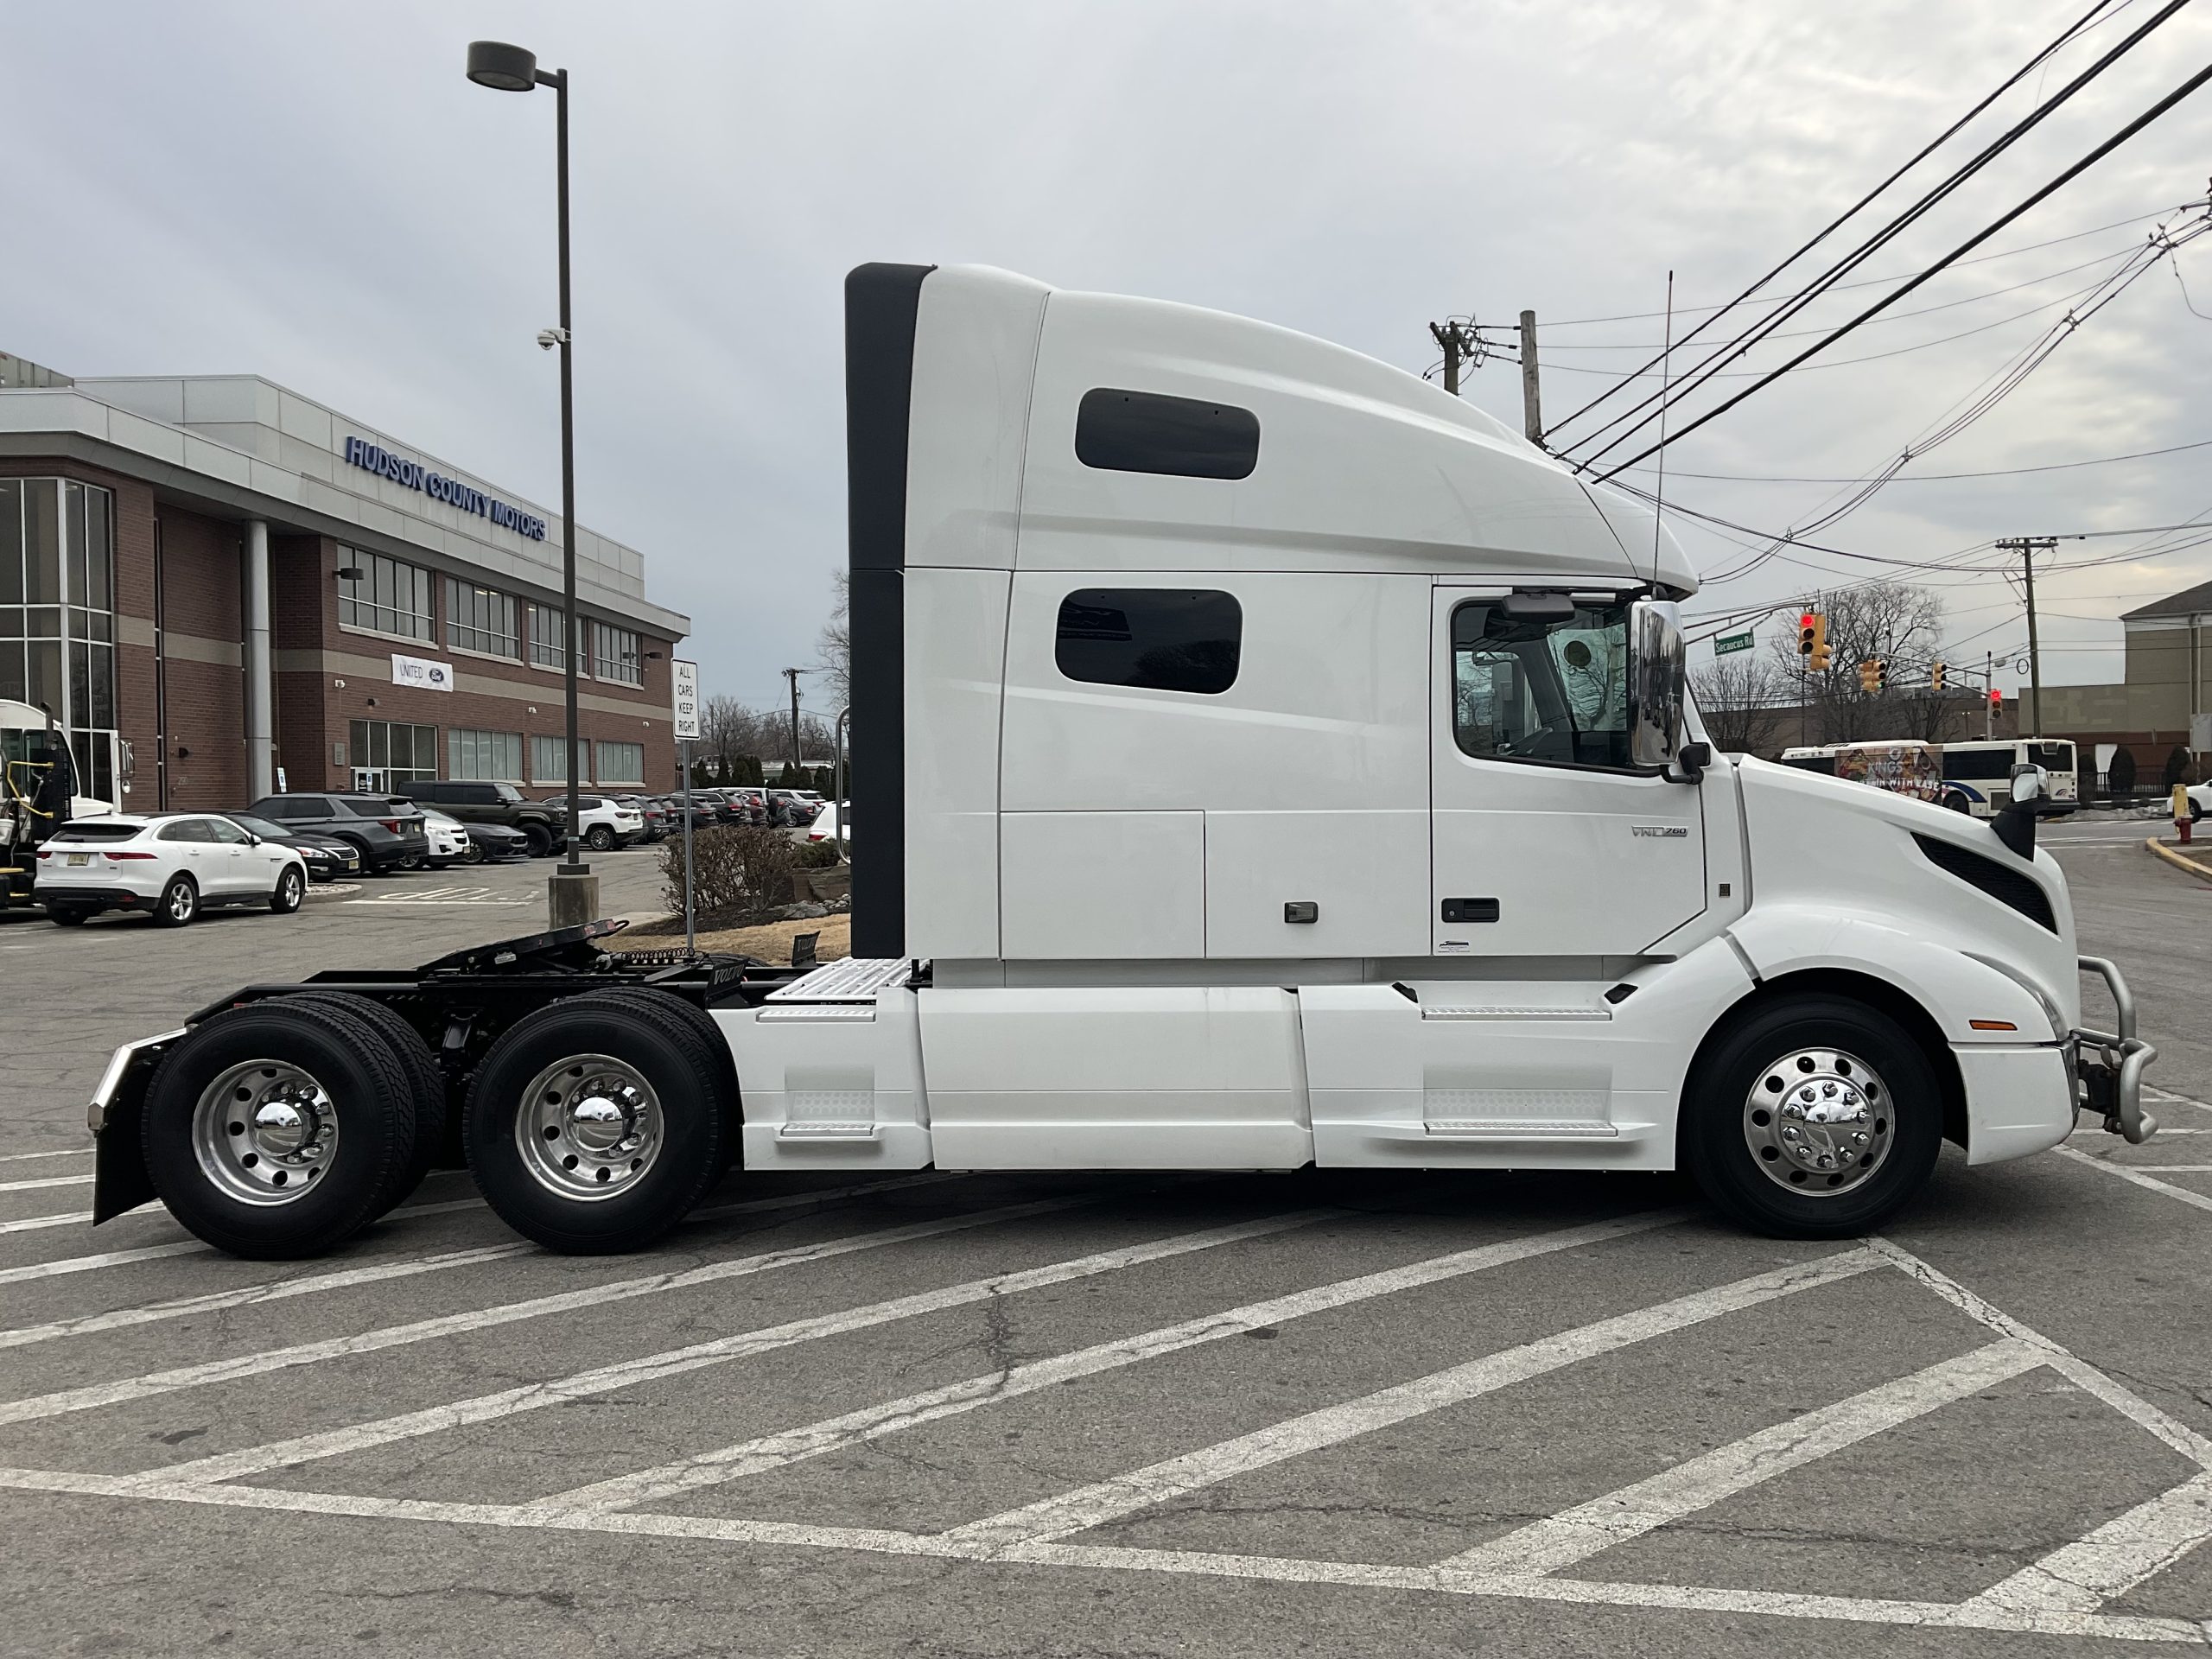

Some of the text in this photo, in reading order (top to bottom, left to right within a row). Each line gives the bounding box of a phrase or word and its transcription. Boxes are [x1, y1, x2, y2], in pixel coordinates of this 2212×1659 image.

[346, 435, 546, 541] HUDSON COUNTY MOTORS
[1715, 635, 1753, 653] Secaucus Rd
[399, 663, 423, 679] UNITED
[679, 666, 690, 678] ALL
[677, 683, 693, 697] CARS
[678, 702, 694, 715] KEEP
[678, 720, 695, 733] RIGHT
[1868, 761, 1904, 773] KINGS
[1890, 779, 1913, 787] WITH
[714, 963, 744, 985] VOLVO
